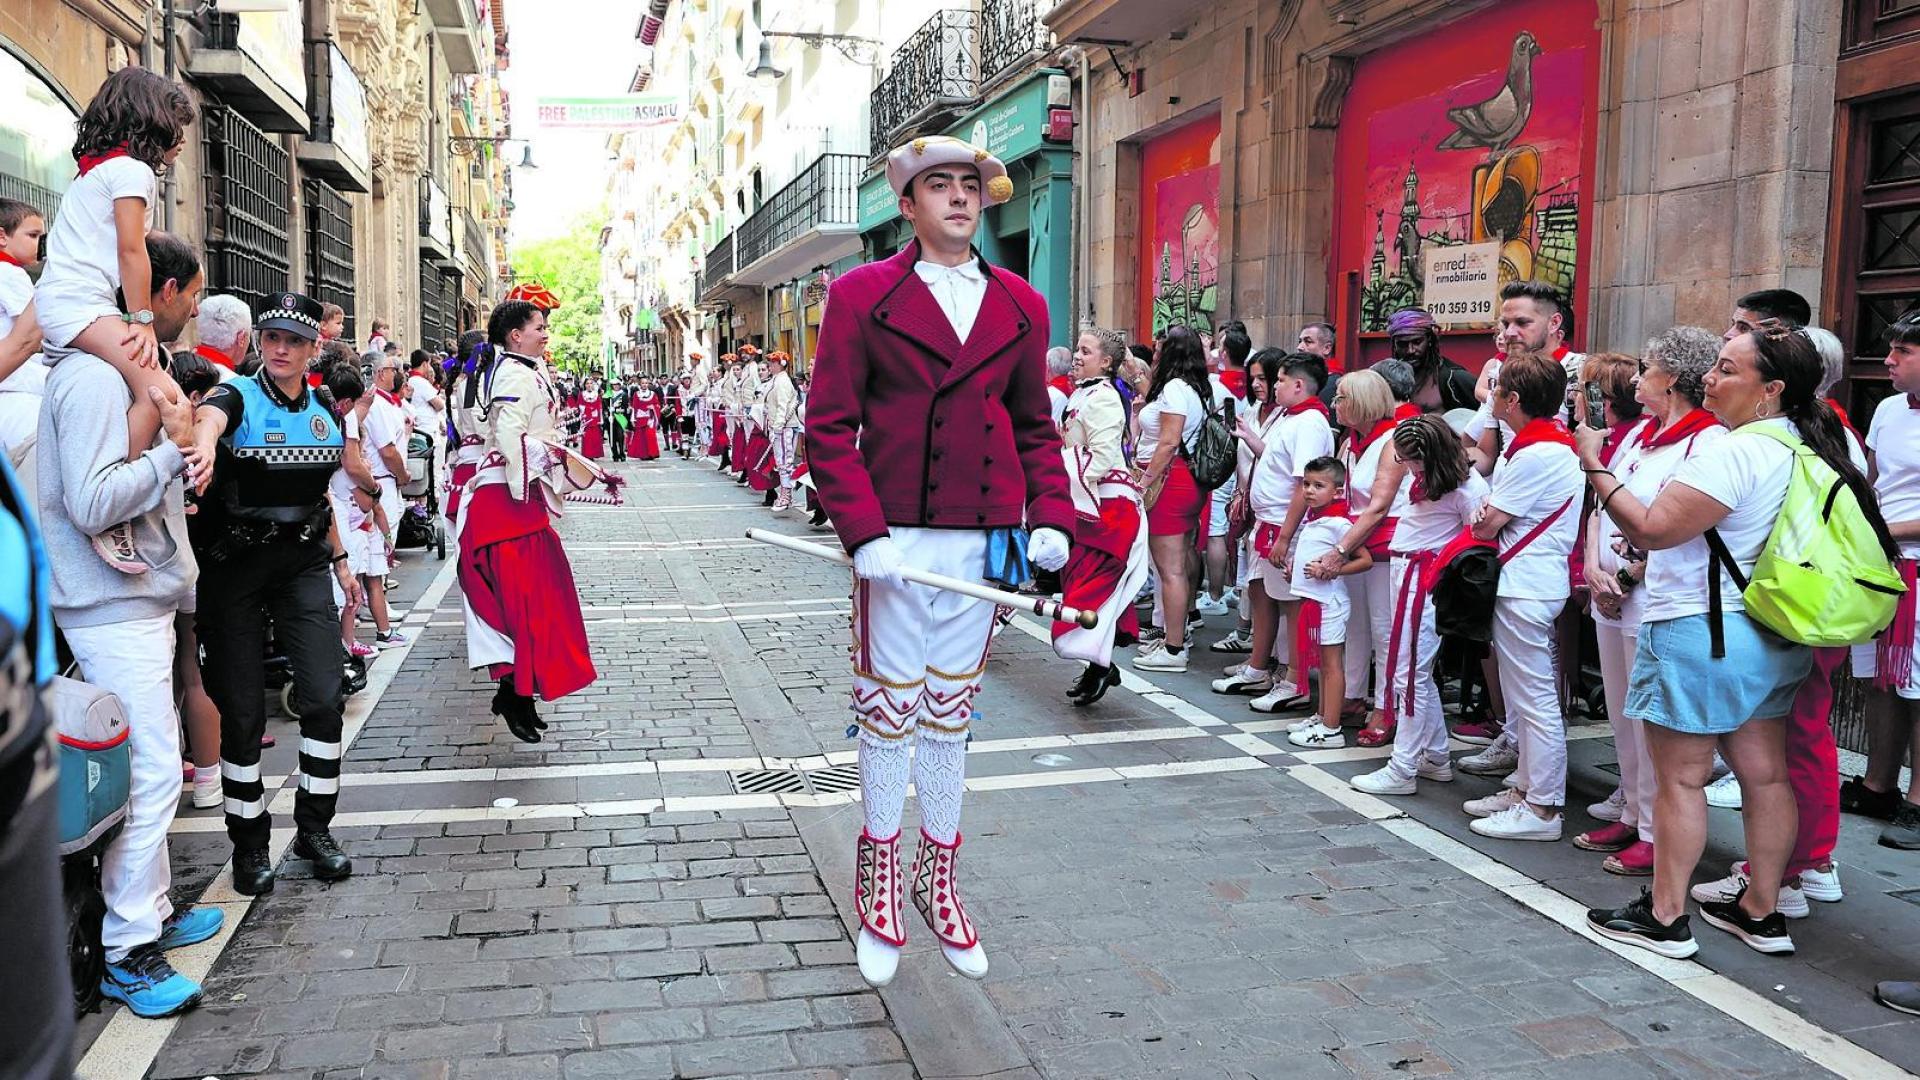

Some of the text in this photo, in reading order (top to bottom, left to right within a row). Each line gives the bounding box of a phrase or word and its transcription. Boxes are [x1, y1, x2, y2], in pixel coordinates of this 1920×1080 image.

[538, 103, 678, 121] FREE PALESTINE ASKATU
[1433, 253, 1466, 271] enred
[1427, 300, 1491, 314] 610 359 319
